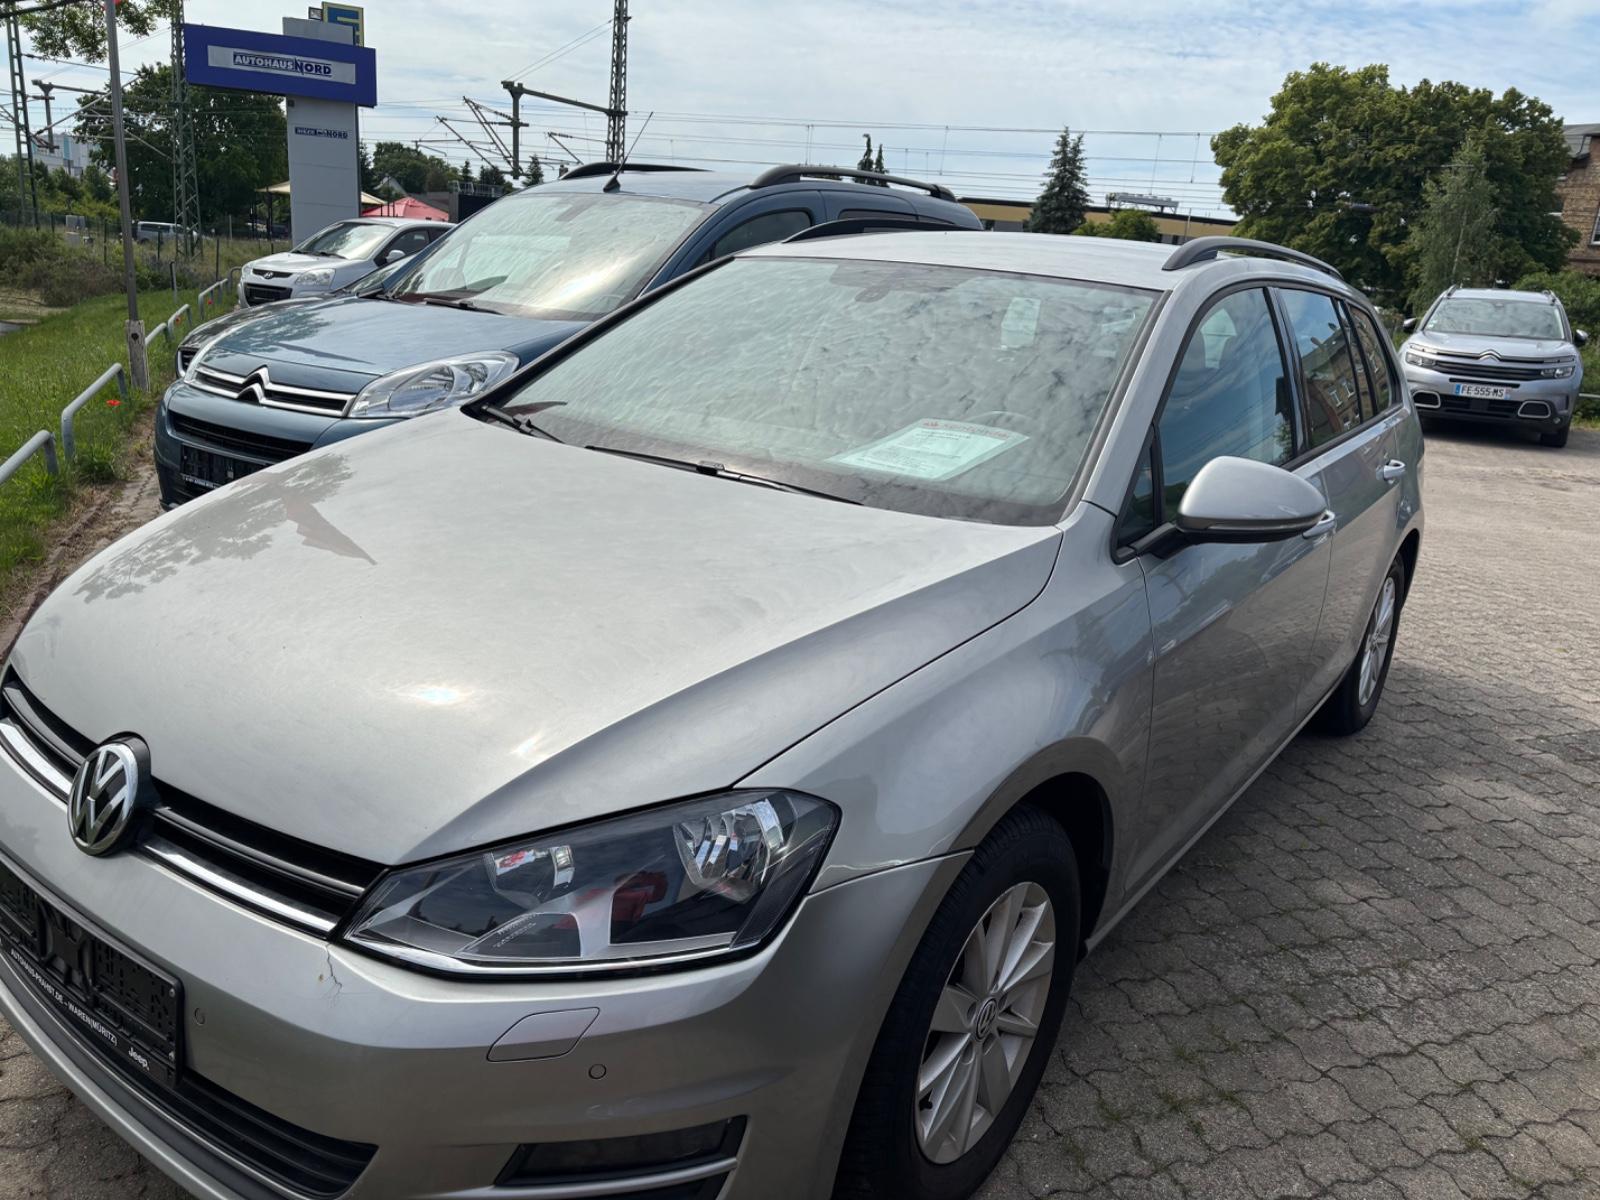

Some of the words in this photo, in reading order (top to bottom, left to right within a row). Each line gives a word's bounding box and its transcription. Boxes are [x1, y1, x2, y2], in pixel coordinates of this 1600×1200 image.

[234, 54, 294, 71] AUTOHAUS
[294, 58, 332, 76] NORD
[128, 1047, 149, 1070] Jeep
